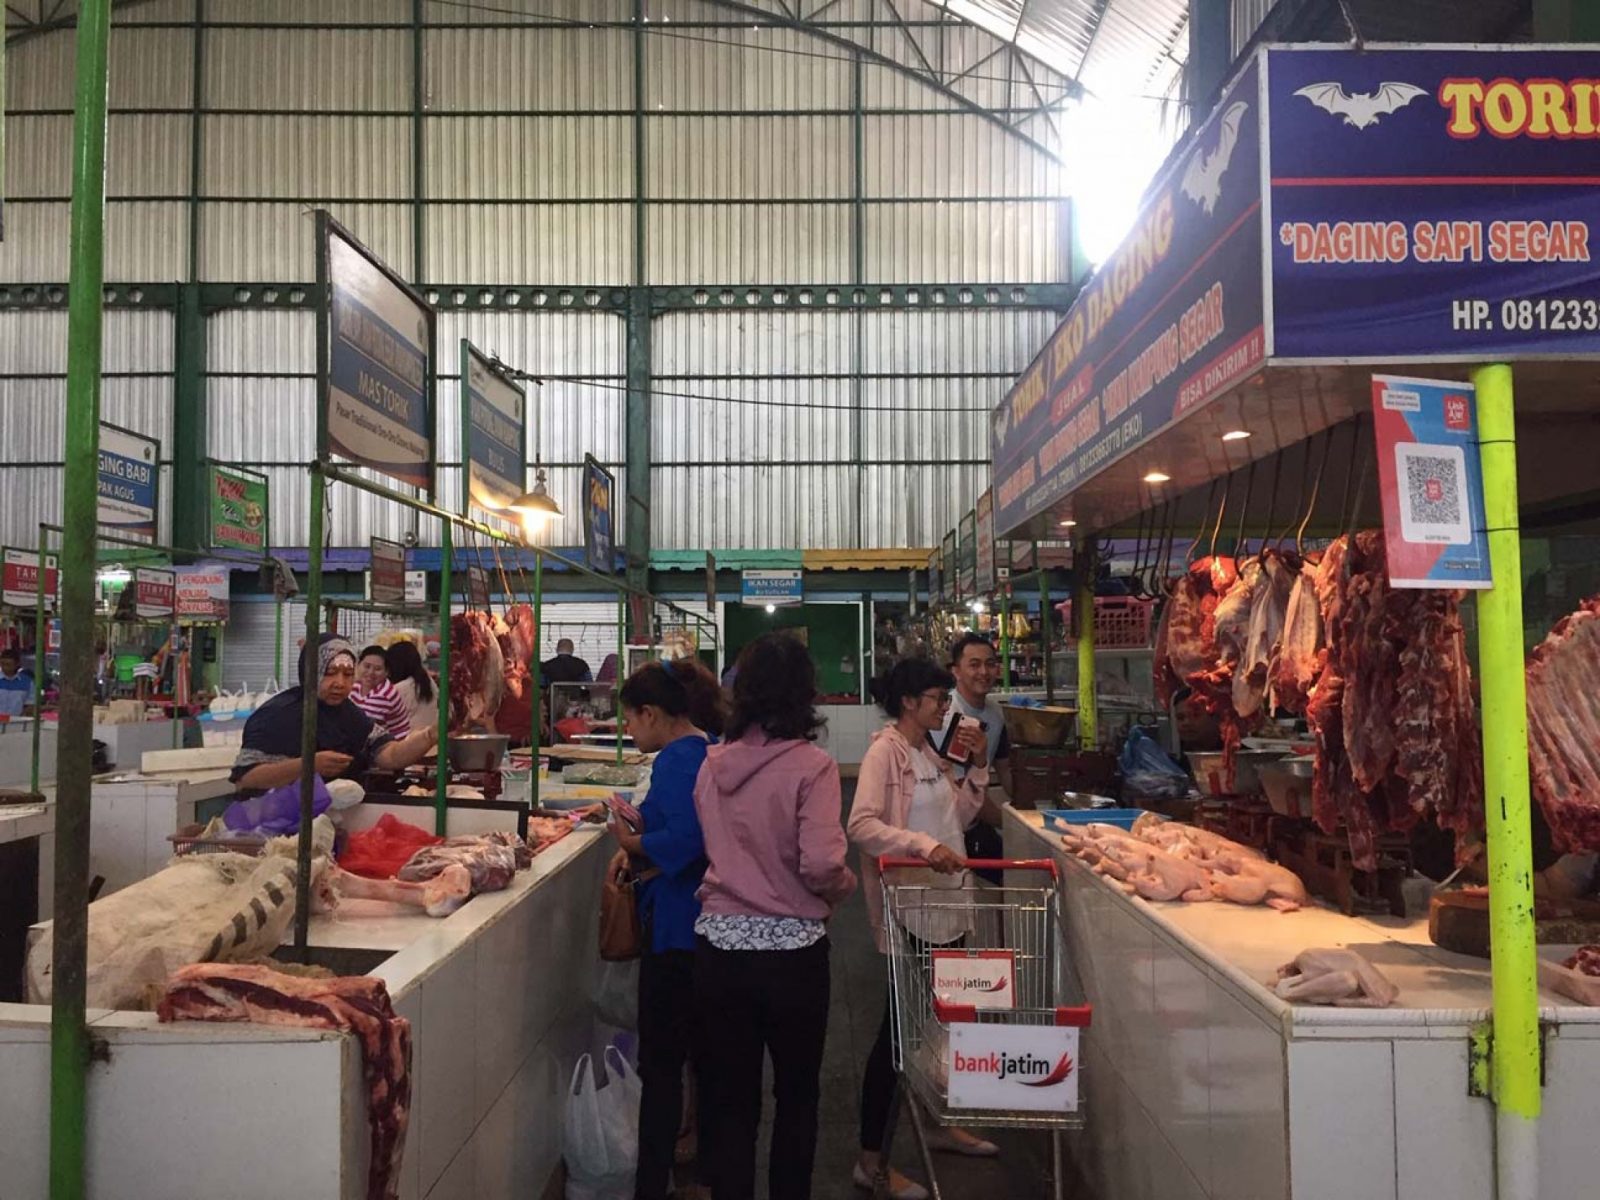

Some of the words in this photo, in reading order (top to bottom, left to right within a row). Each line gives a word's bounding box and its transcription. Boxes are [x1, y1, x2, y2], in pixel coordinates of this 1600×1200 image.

[1438, 77, 1600, 139] TORI
[1413, 221, 1482, 262] SAPI
[1488, 221, 1590, 262] SEGAR
[1054, 308, 1085, 382] EKO
[1086, 189, 1175, 343] DAGING
[1179, 281, 1224, 365] SEGAR
[1452, 300, 1492, 330] HP.
[1501, 299, 1600, 330] 081233
[1180, 380, 1203, 409] BISA
[1205, 344, 1247, 393] DIKIRIM
[1057, 378, 1085, 417] JUAL
[98, 454, 124, 476] GING
[126, 462, 150, 484] BABI
[114, 485, 135, 501] AGUS
[15, 567, 37, 578] TAH
[769, 579, 796, 588] SEGAR
[937, 977, 991, 990] bankjatim
[954, 1051, 1050, 1079] bankjatim
